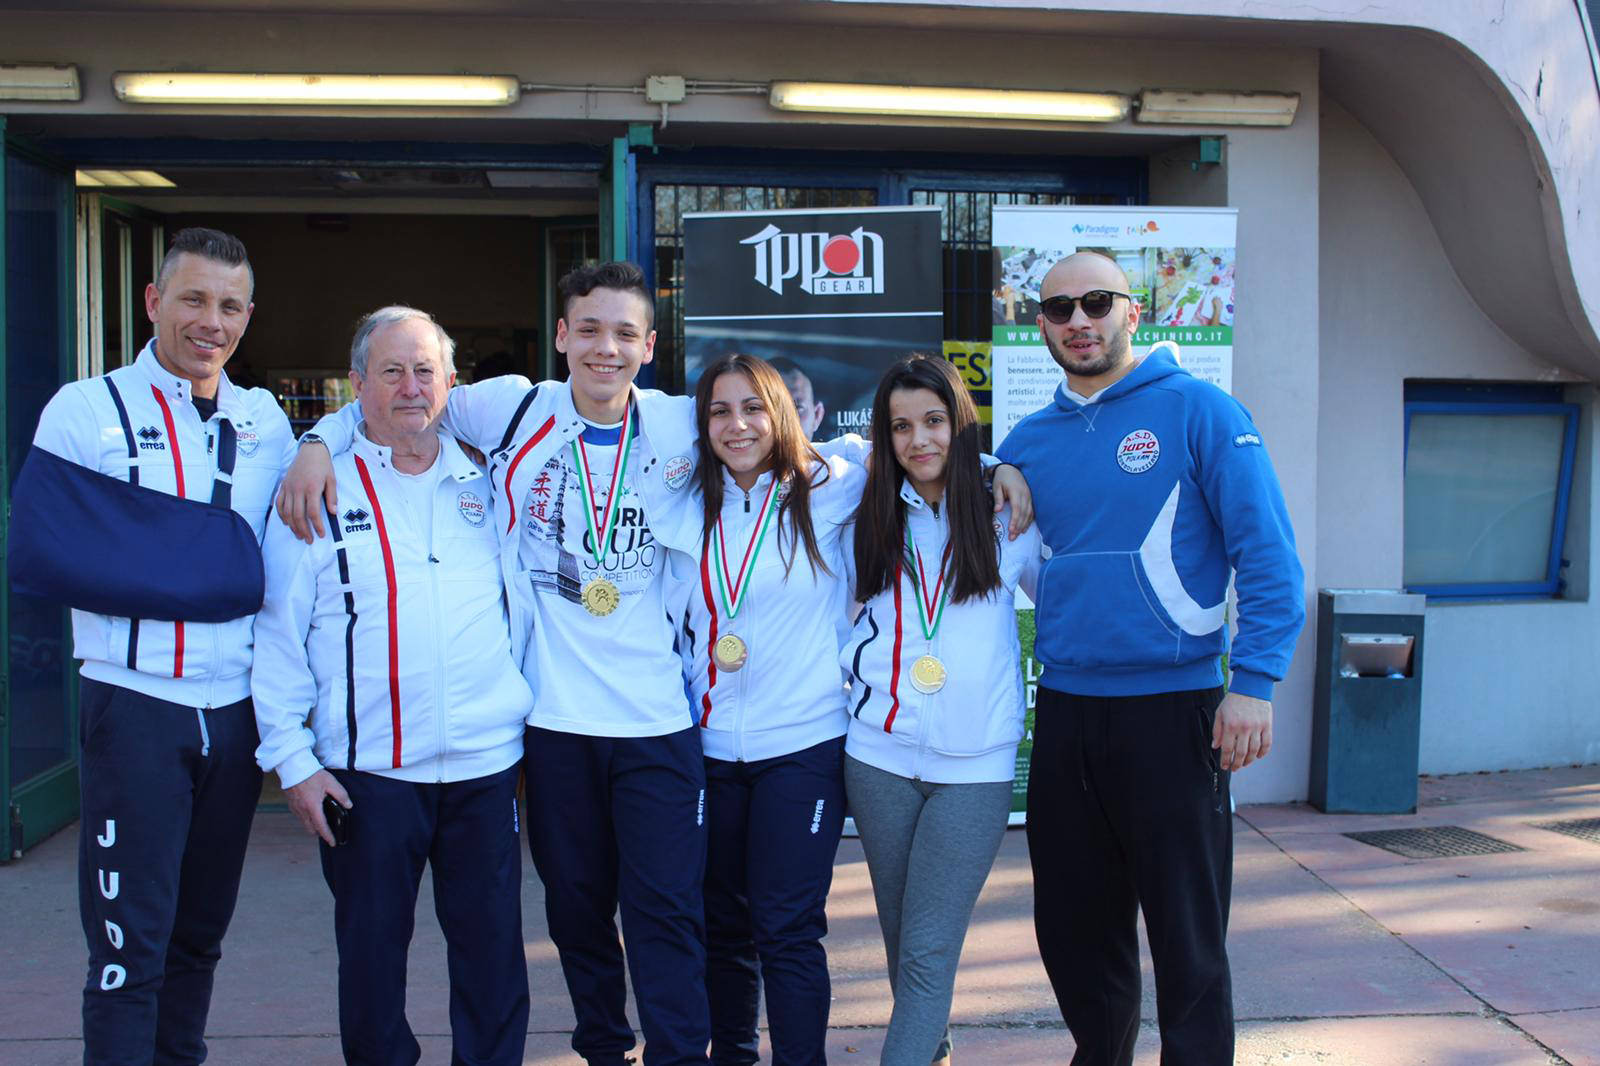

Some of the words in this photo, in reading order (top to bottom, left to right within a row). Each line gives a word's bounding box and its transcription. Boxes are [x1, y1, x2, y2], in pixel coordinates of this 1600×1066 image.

[820, 281, 866, 293] GEAR
[1007, 366, 1044, 375] benessere,
[139, 441, 166, 451] errea
[1121, 441, 1157, 454] JUDO
[665, 463, 690, 481] JUDO
[460, 501, 483, 511] JUDO
[345, 522, 372, 534] errea
[813, 799, 825, 822] errea
[97, 819, 127, 991] JUDO
